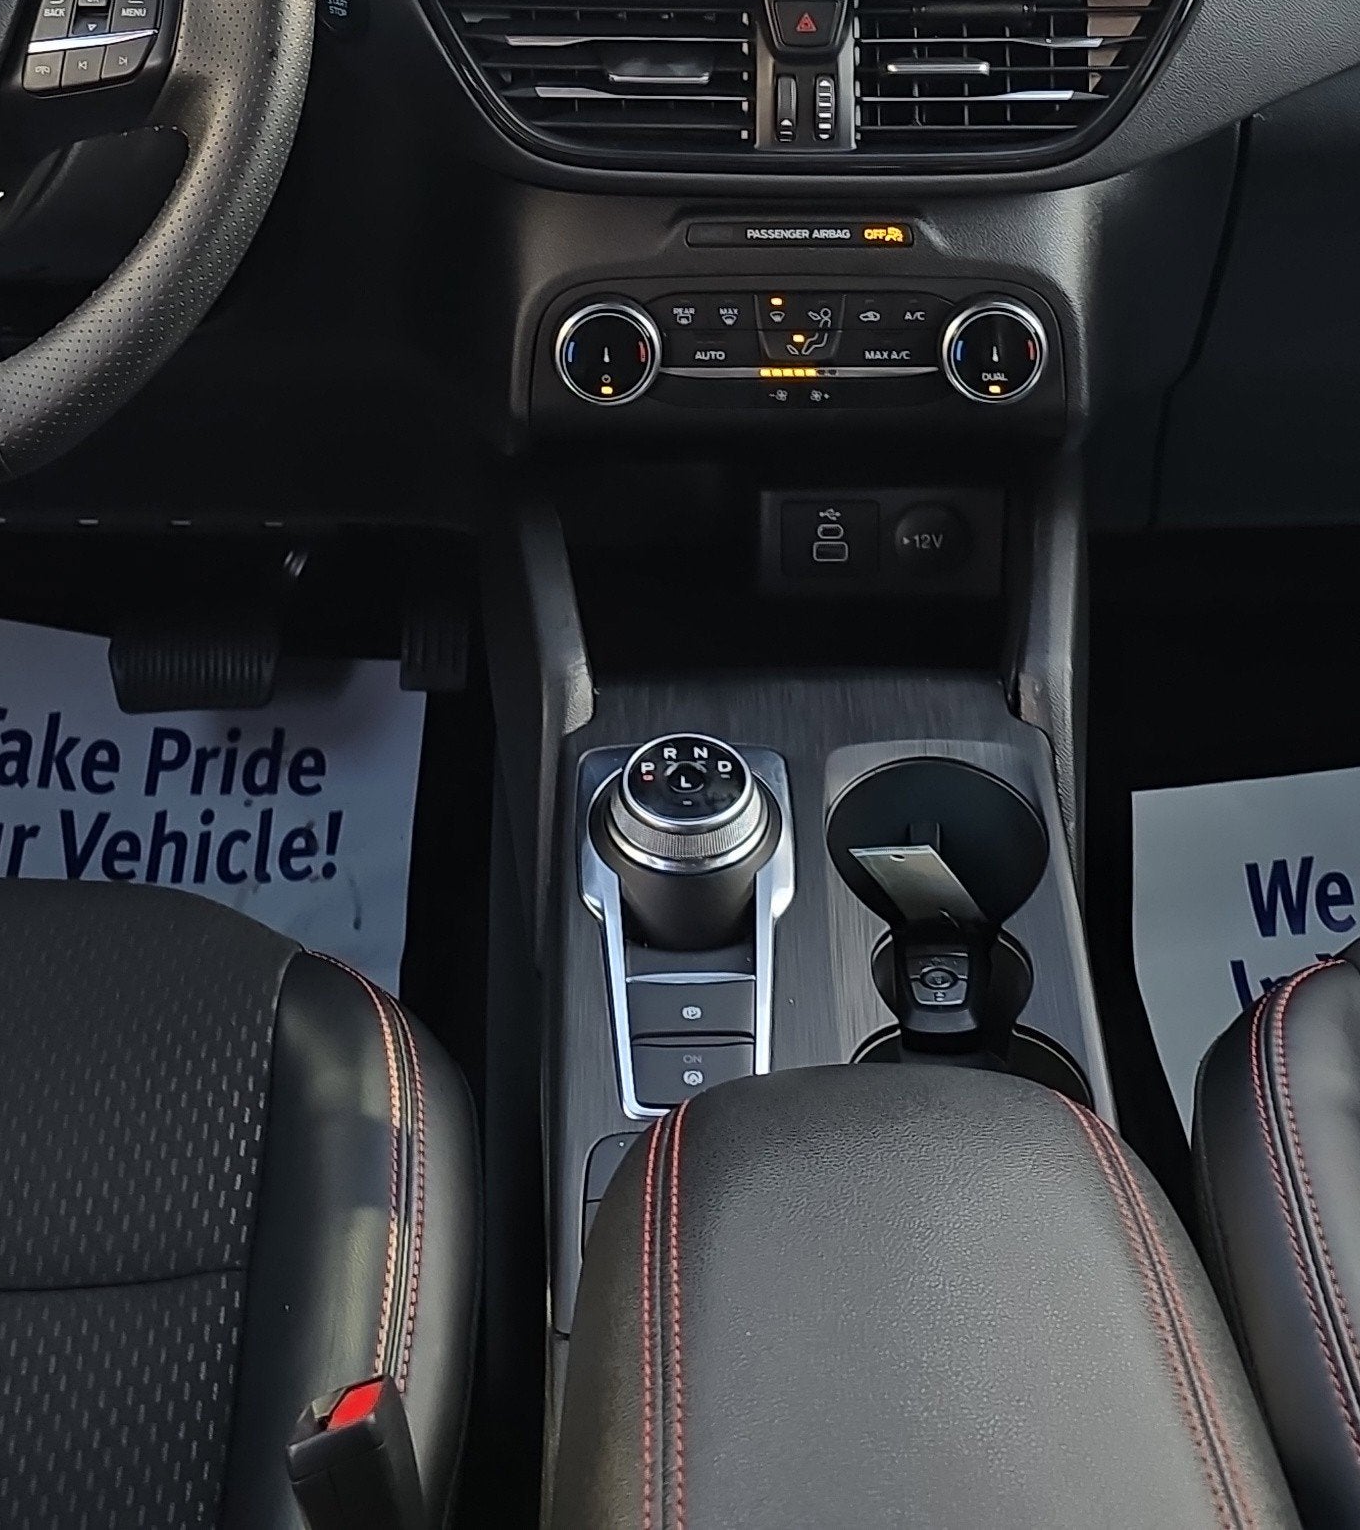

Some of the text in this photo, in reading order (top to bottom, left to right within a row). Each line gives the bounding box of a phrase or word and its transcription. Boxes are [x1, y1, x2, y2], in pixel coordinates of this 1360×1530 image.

[43, 8, 66, 17] BACK
[121, 8, 147, 17] MENU
[746, 228, 810, 240] PASSENGER
[811, 228, 851, 240] AIRBAG
[672, 307, 696, 316] REAR
[719, 307, 739, 316] MAX
[904, 311, 926, 321] A/C
[694, 350, 726, 361] AUTO
[864, 350, 911, 360] MAX A/C
[981, 372, 1008, 382] DUAL
[913, 533, 944, 549] 12V
[663, 746, 678, 760] R
[694, 746, 708, 760] N
[144, 726, 327, 798] Pride
[640, 761, 655, 775] P
[717, 760, 732, 774] D
[680, 775, 692, 788] L
[58, 808, 344, 884] Vehicle!
[1244, 855, 1357, 938] We
